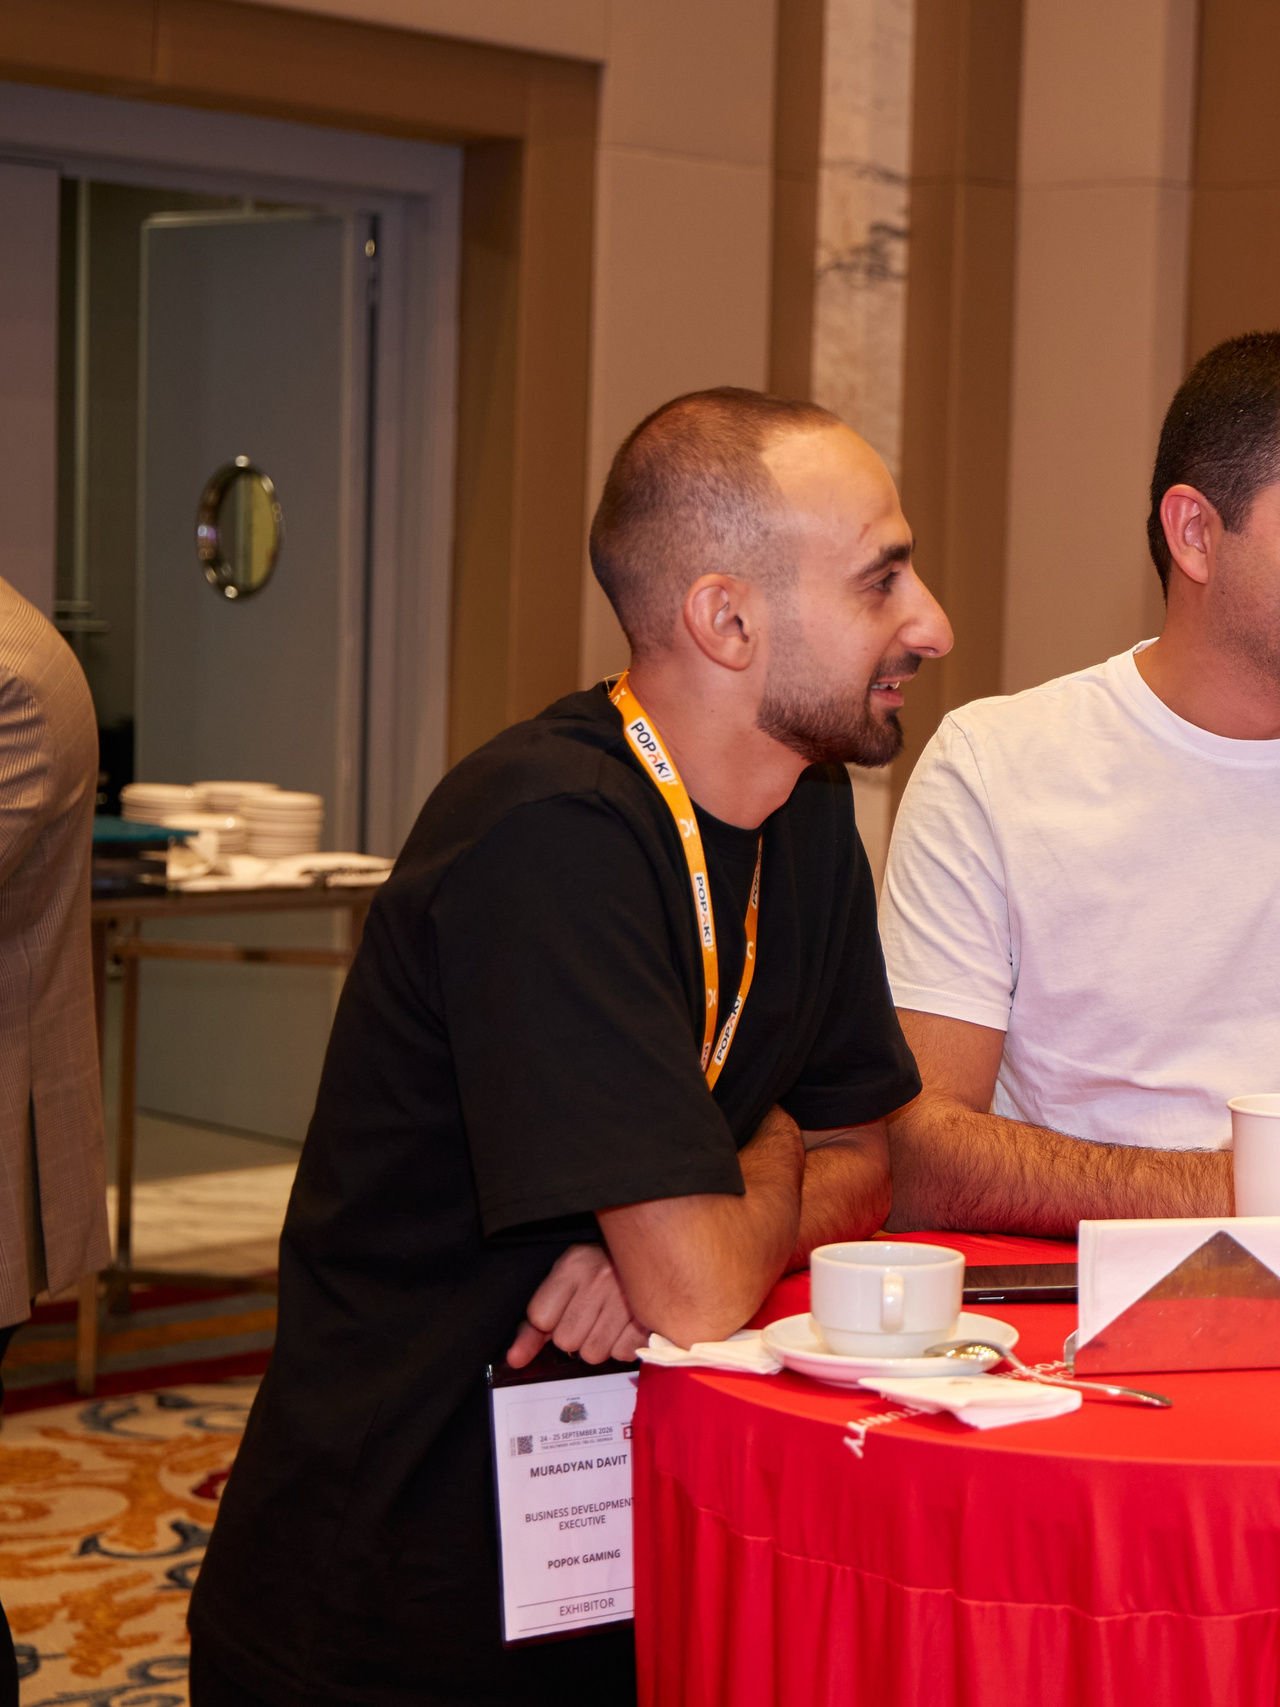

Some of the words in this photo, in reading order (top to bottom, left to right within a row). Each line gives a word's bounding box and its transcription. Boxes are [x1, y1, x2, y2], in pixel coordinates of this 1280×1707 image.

[562, 1428, 597, 1440] SEPTEMBER
[530, 1459, 594, 1478] MURADYAN
[597, 1454, 627, 1468] DAVIT
[525, 1507, 569, 1523] BUSINESS
[559, 1515, 606, 1530] EXECUTIVE
[547, 1555, 580, 1569] POPOK
[582, 1549, 621, 1564] GAMING
[559, 1598, 615, 1616] EXHIBITOR
